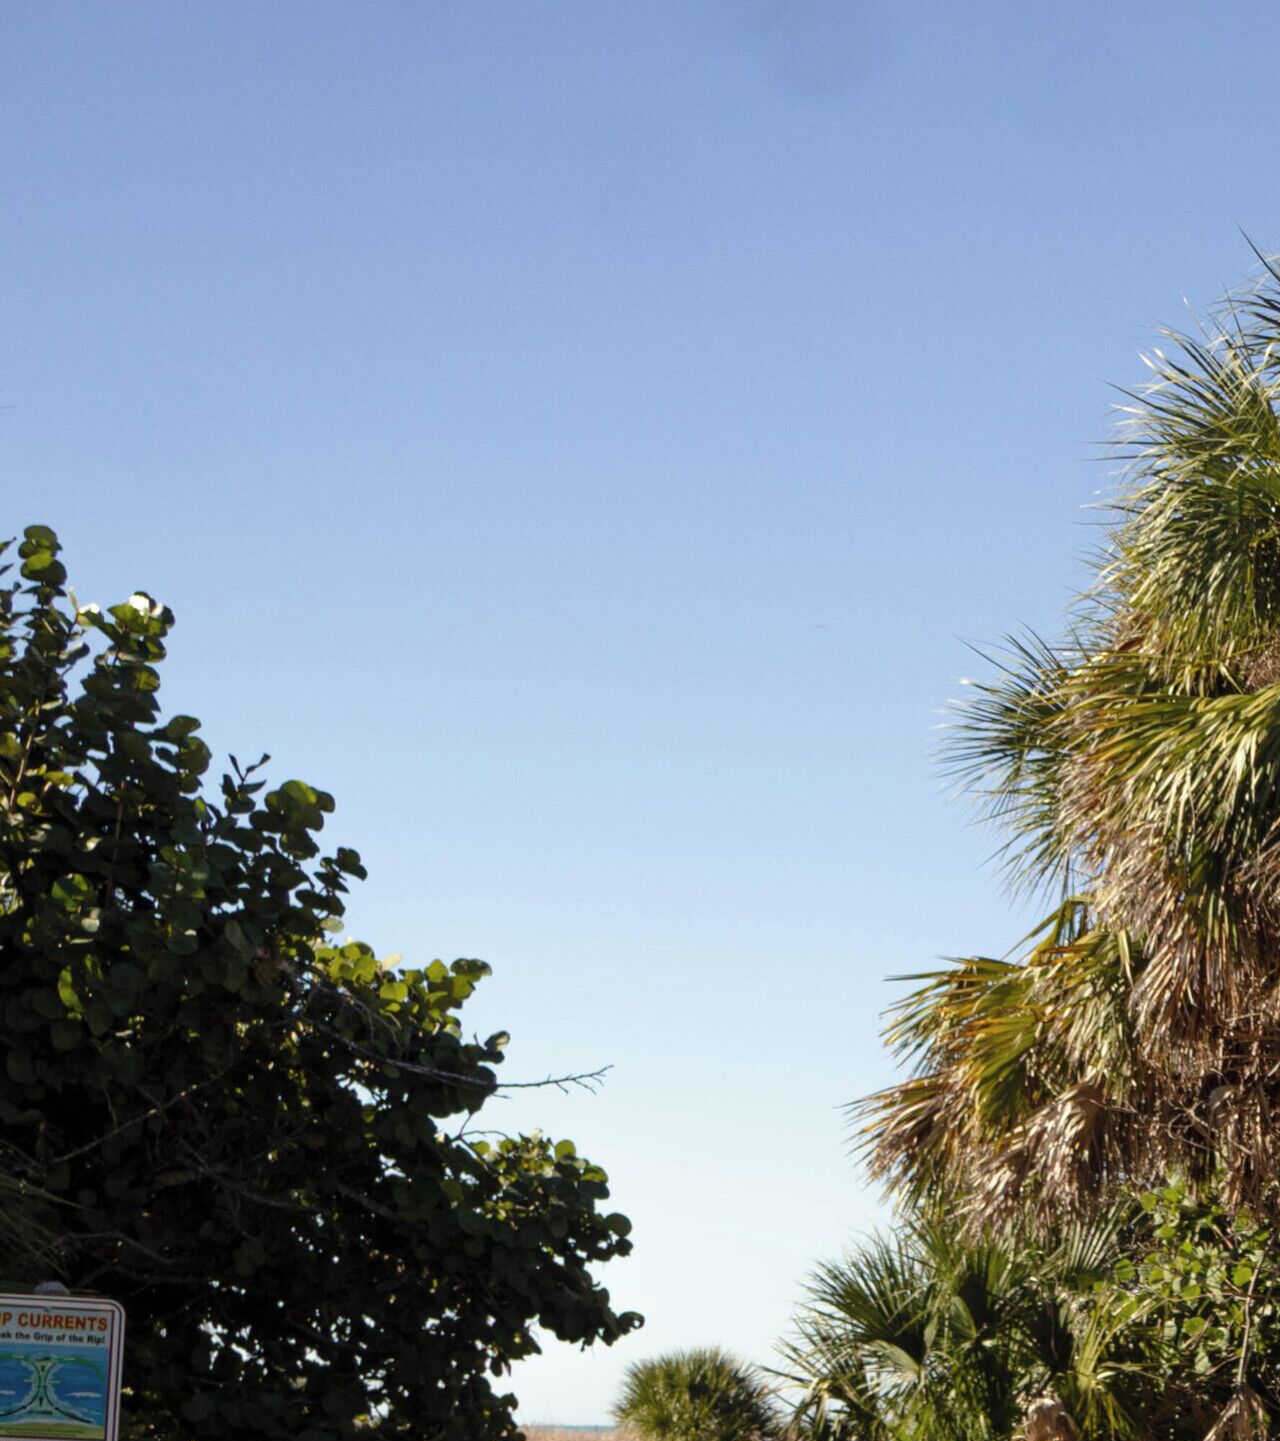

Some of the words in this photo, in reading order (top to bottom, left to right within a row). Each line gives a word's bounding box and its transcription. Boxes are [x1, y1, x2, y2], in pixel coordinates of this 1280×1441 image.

[18, 1312, 108, 1332] CURRENTS
[15, 1331, 30, 1340] the
[33, 1332, 53, 1343] Grip
[68, 1334, 83, 1342] the
[86, 1335, 105, 1345] Rip!
